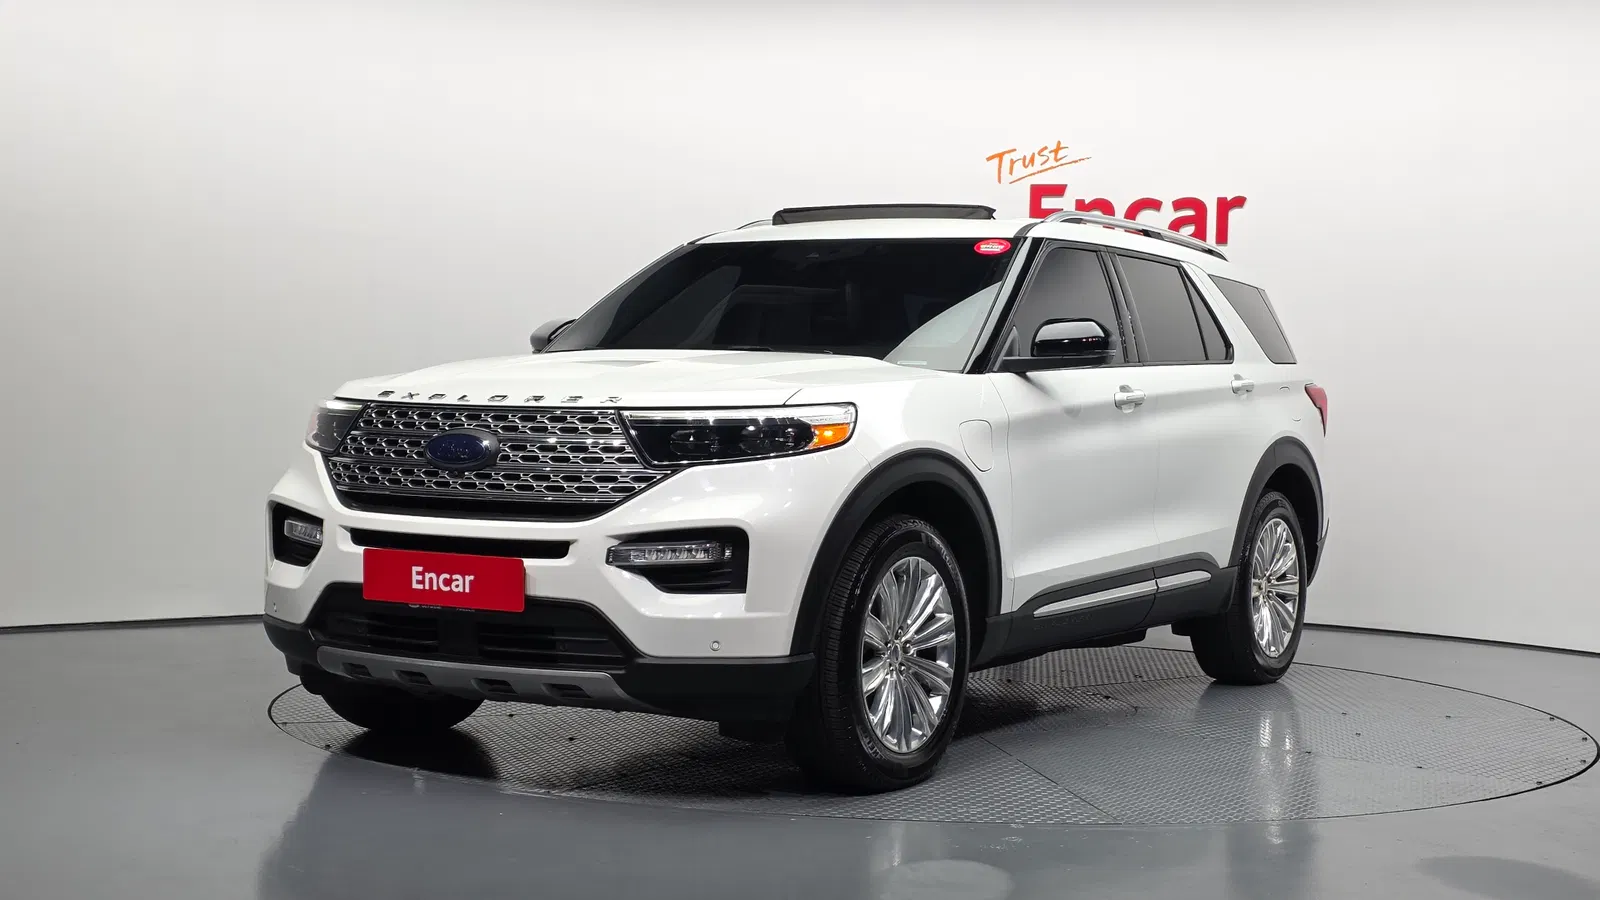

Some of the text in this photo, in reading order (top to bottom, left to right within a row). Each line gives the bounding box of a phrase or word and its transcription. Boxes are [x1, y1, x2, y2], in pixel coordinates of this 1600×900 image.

[986, 140, 1069, 184] Trust
[377, 390, 622, 403] EXPLORER
[411, 566, 475, 593] Encar
